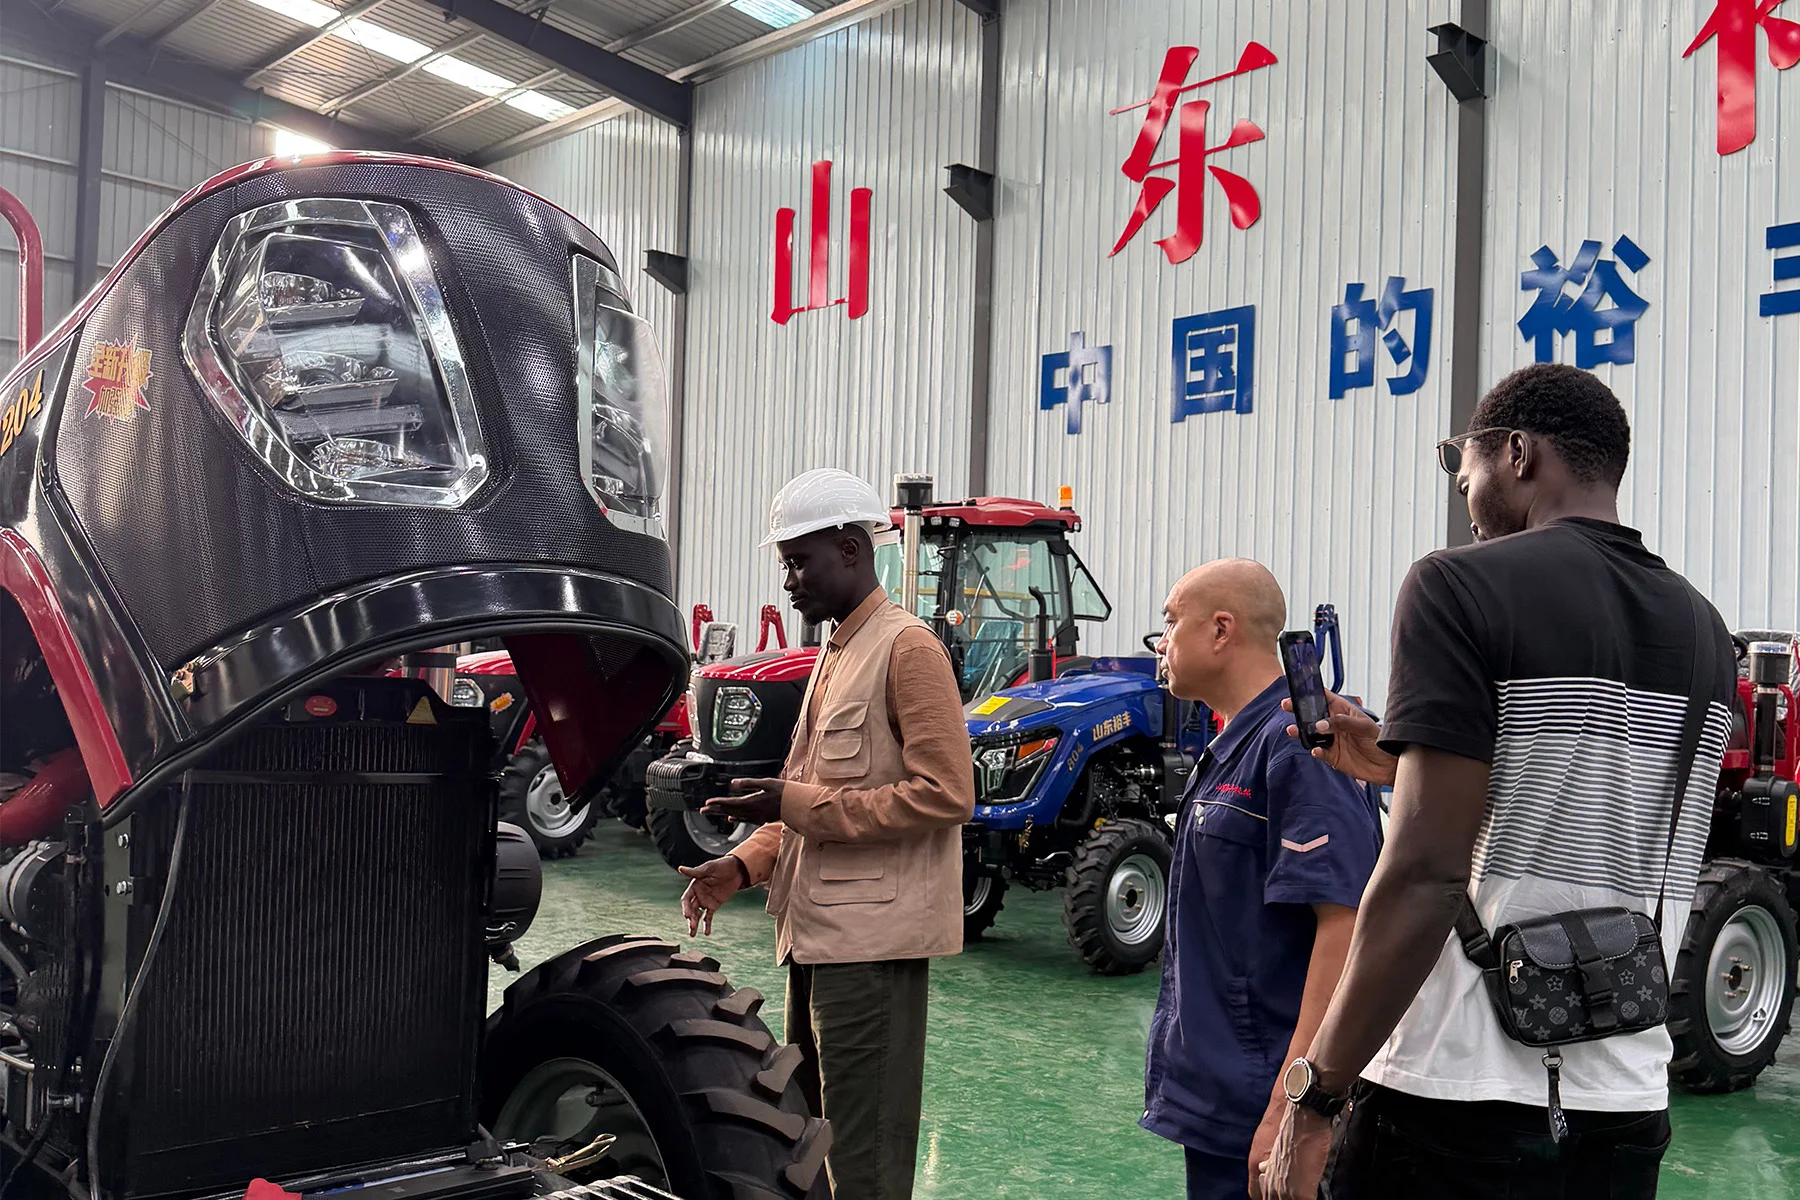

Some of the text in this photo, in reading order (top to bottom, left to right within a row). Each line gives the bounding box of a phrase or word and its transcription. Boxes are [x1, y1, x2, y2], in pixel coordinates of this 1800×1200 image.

[0, 368, 43, 457] 204
[1092, 711, 1131, 742] 山东裕丰
